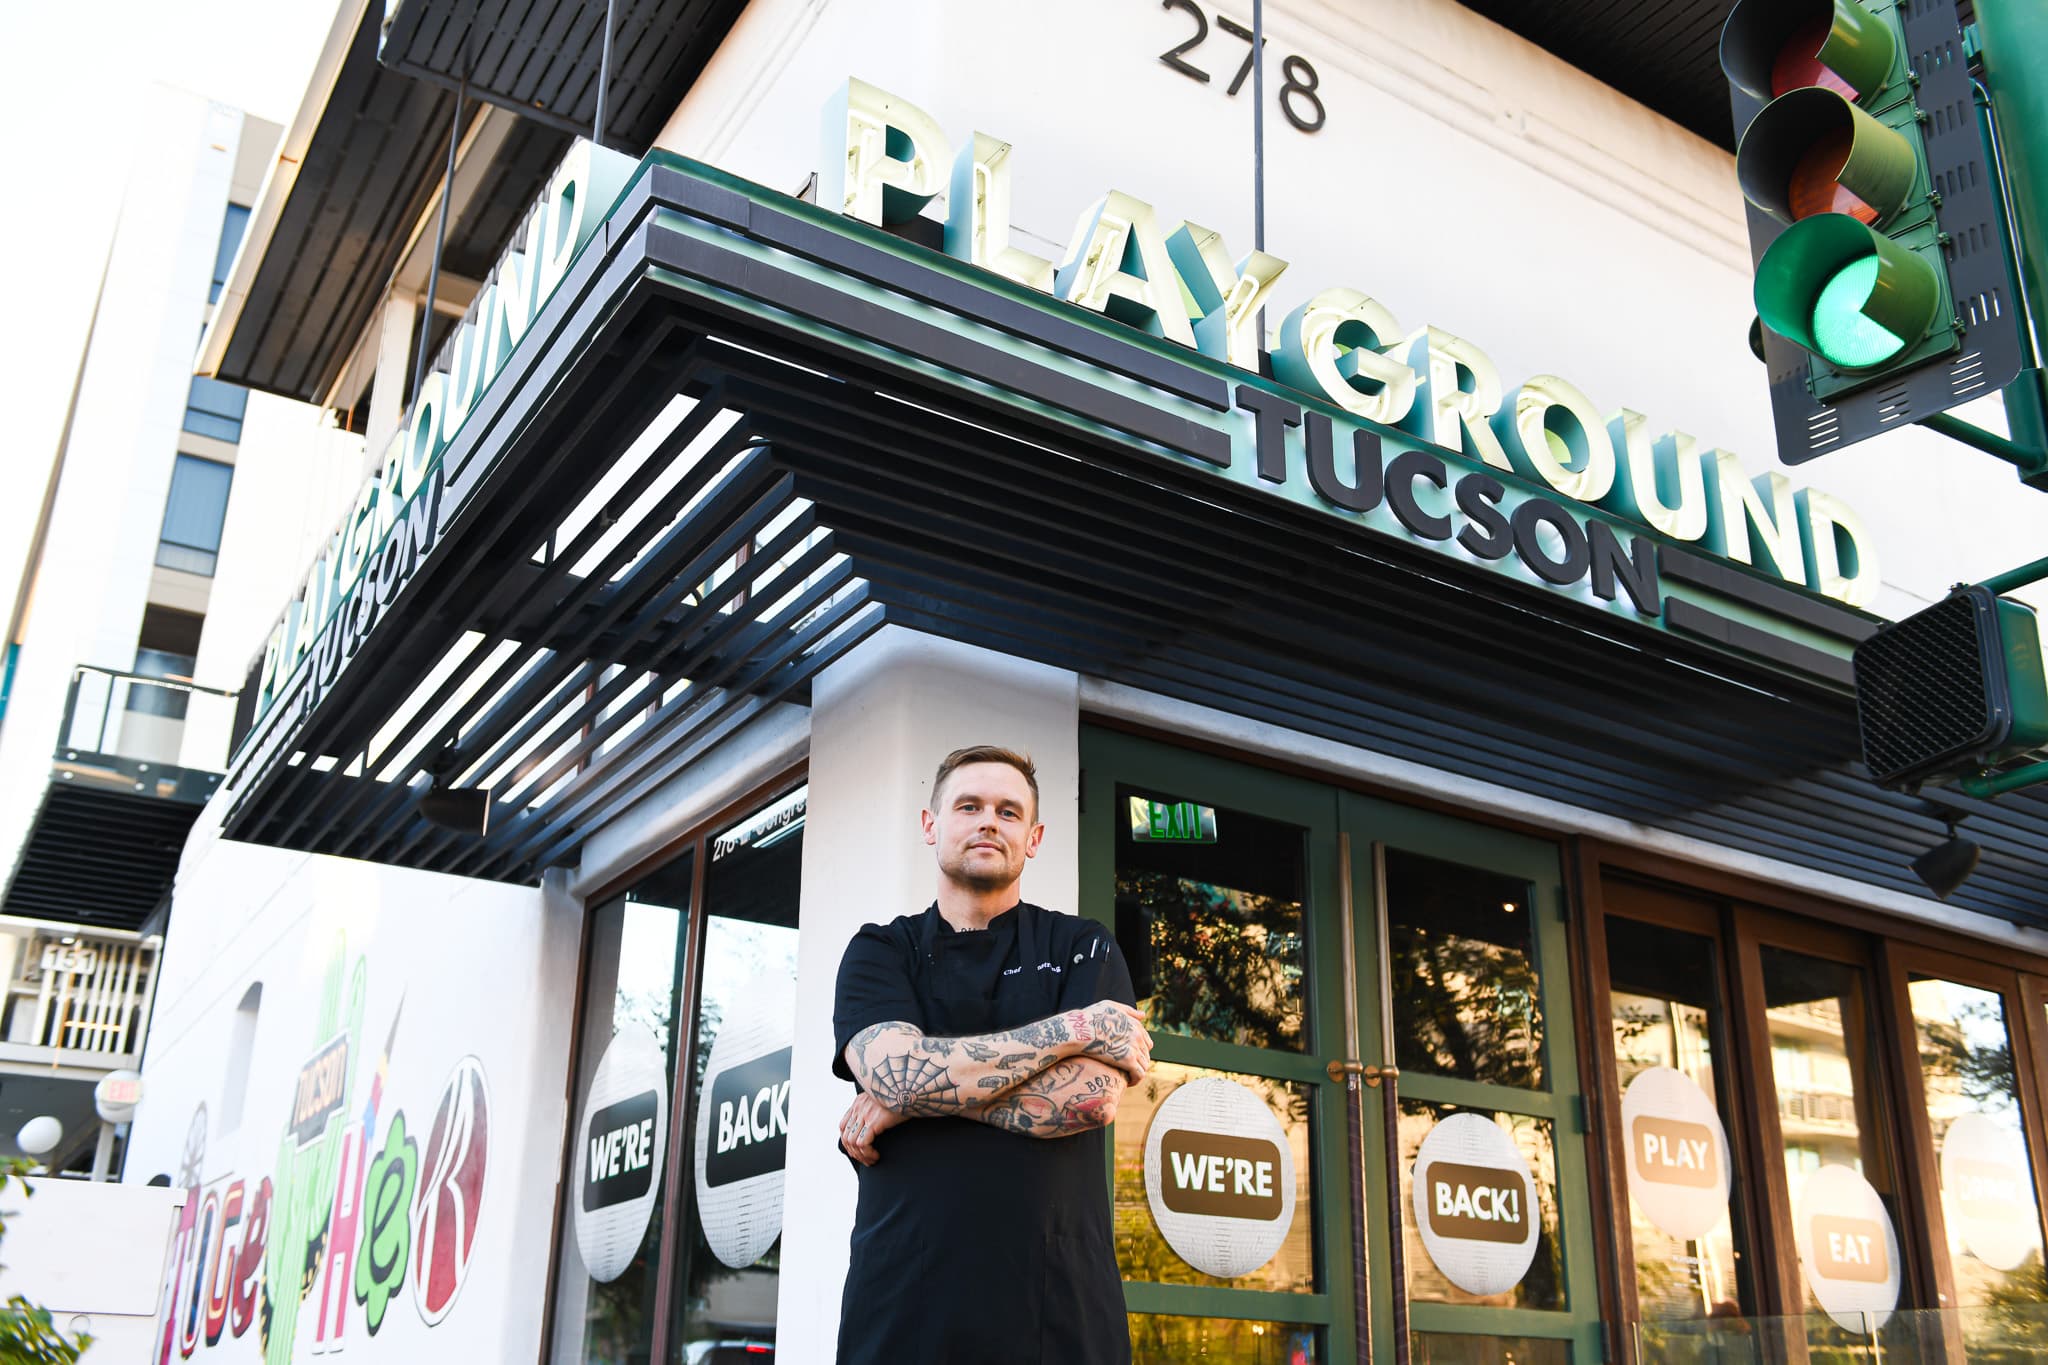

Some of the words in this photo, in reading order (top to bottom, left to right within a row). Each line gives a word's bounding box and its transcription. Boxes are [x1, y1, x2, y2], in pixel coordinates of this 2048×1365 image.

[1159, 0, 1326, 133] 278
[822, 75, 1880, 609] PLAYGROUND
[251, 136, 612, 728] PLAYGROUND
[1235, 384, 1660, 619] TUCSON
[302, 467, 444, 714] TUCSON
[590, 1118, 653, 1184] WE'RE
[1170, 1151, 1273, 1197] WE'RE
[1643, 1132, 1708, 1171] PLAY
[1435, 1181, 1520, 1224] BACK!
[1828, 1232, 1871, 1265] EAT
